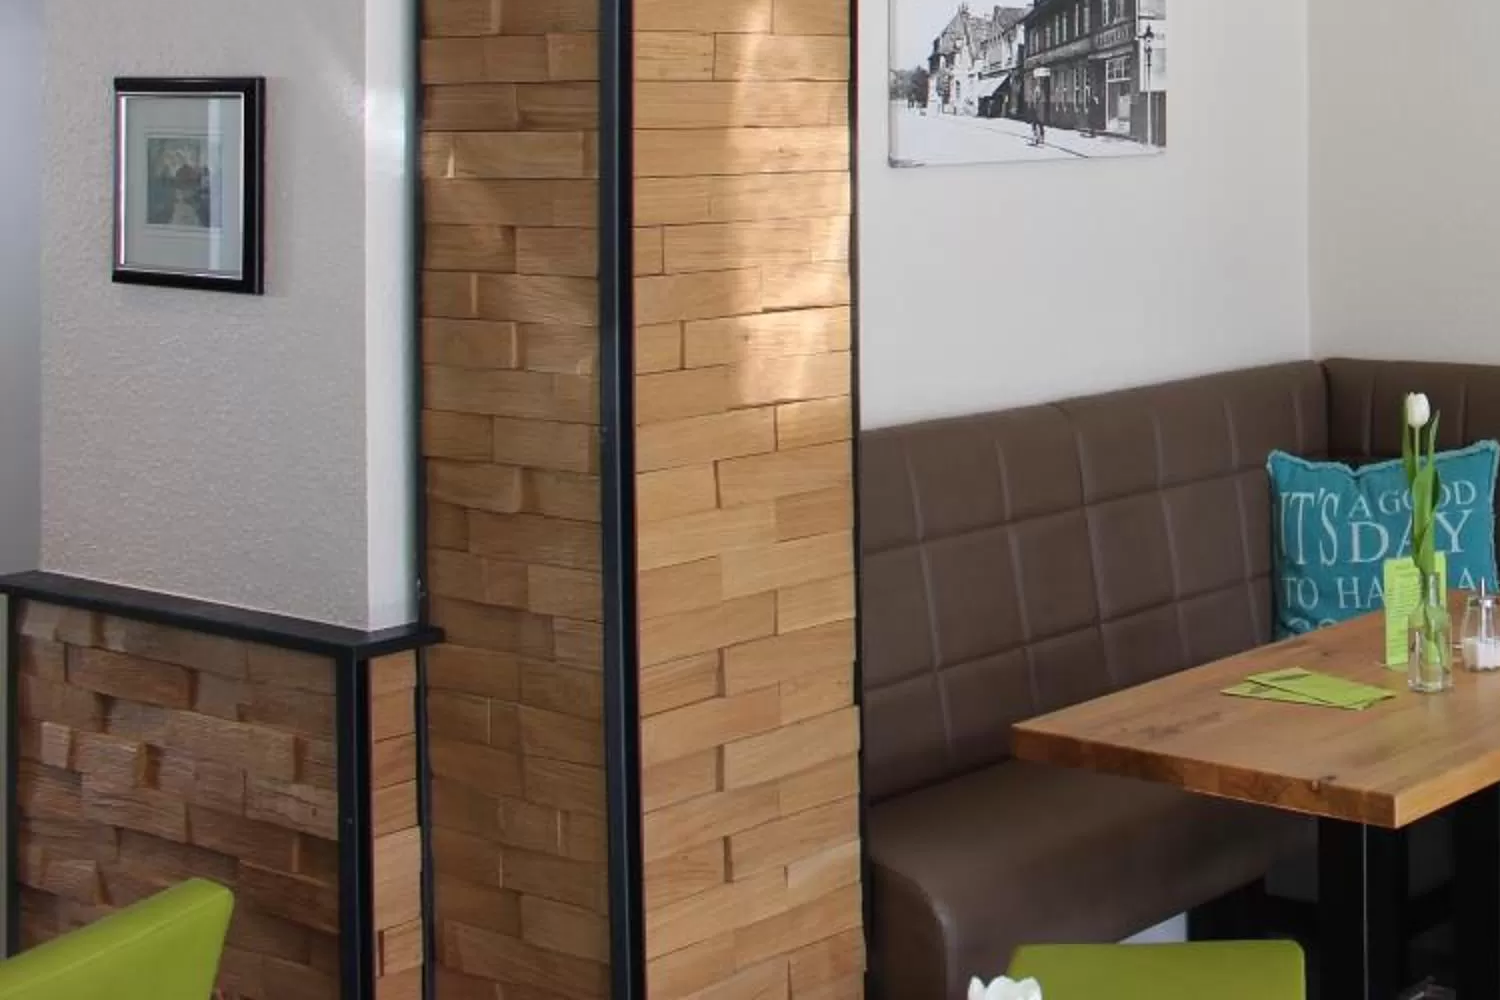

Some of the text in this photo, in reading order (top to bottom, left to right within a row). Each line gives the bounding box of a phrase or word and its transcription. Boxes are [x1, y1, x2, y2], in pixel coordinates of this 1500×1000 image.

[1279, 487, 1340, 567] IT'S
[1349, 493, 1373, 519] A
[1280, 576, 1319, 610] TO
[1335, 575, 1387, 609] HA
